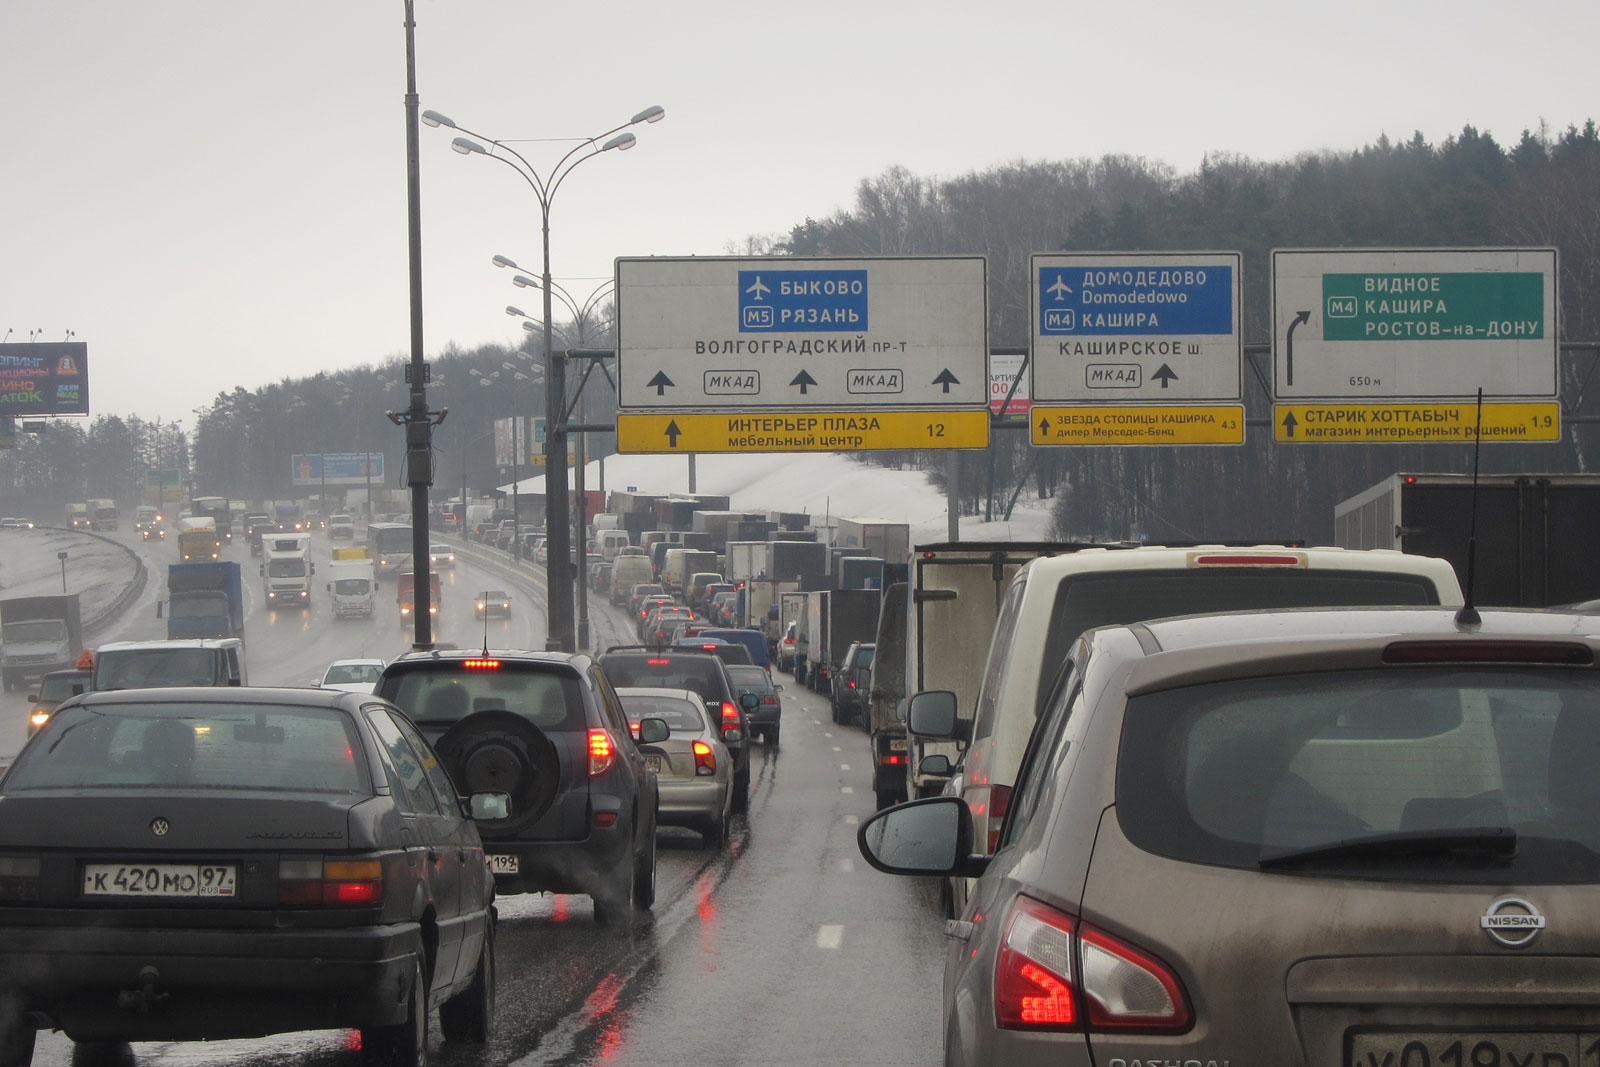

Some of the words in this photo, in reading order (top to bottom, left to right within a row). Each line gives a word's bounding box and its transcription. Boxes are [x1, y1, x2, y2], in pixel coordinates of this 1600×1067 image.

[1082, 271, 1207, 288] ДОМОДЕДОВО
[1365, 277, 1441, 294] ВИДНОЕ
[780, 280, 863, 296] БЫКОВО
[1082, 290, 1188, 304] Domodedowo
[1365, 299, 1447, 314] КАШИРА
[781, 309, 860, 324] РЯЗАНЬ
[1082, 313, 1159, 328] КАШИРА
[1365, 320, 1539, 337] РОСТОВ-на-ДОНУ
[695, 335, 867, 356] ВОЛГОГРАДСКИЙ
[1059, 341, 1182, 355] КАШИРСКОЕ
[709, 376, 755, 389] МКАД
[852, 375, 898, 388] МКАД
[1091, 370, 1137, 382] МКАД
[1349, 376, 1371, 387] 650
[1057, 415, 1101, 425] ЗВЕЗДА
[1103, 414, 1160, 426] СТОЛИЦЫ
[1161, 414, 1216, 425] КАШИРКА
[1221, 420, 1237, 430] 4.3
[1304, 410, 1367, 423] СТАРИК
[1371, 409, 1459, 423] ХОТТАБЫЧ
[1531, 416, 1553, 428] 1.9
[728, 418, 818, 432] ИНТЕРЬЕР
[823, 417, 881, 432] ПЛАЗА
[926, 424, 945, 437] 12
[1057, 428, 1090, 438] дилер
[1092, 427, 1175, 437] Мерседес-Бенц
[1304, 427, 1362, 438] магазин
[1365, 426, 1461, 439] интерьерных
[1465, 424, 1527, 438] решений
[728, 433, 817, 447] мебельный
[820, 434, 863, 448] центр
[1488, 917, 1539, 926] NISSAN
